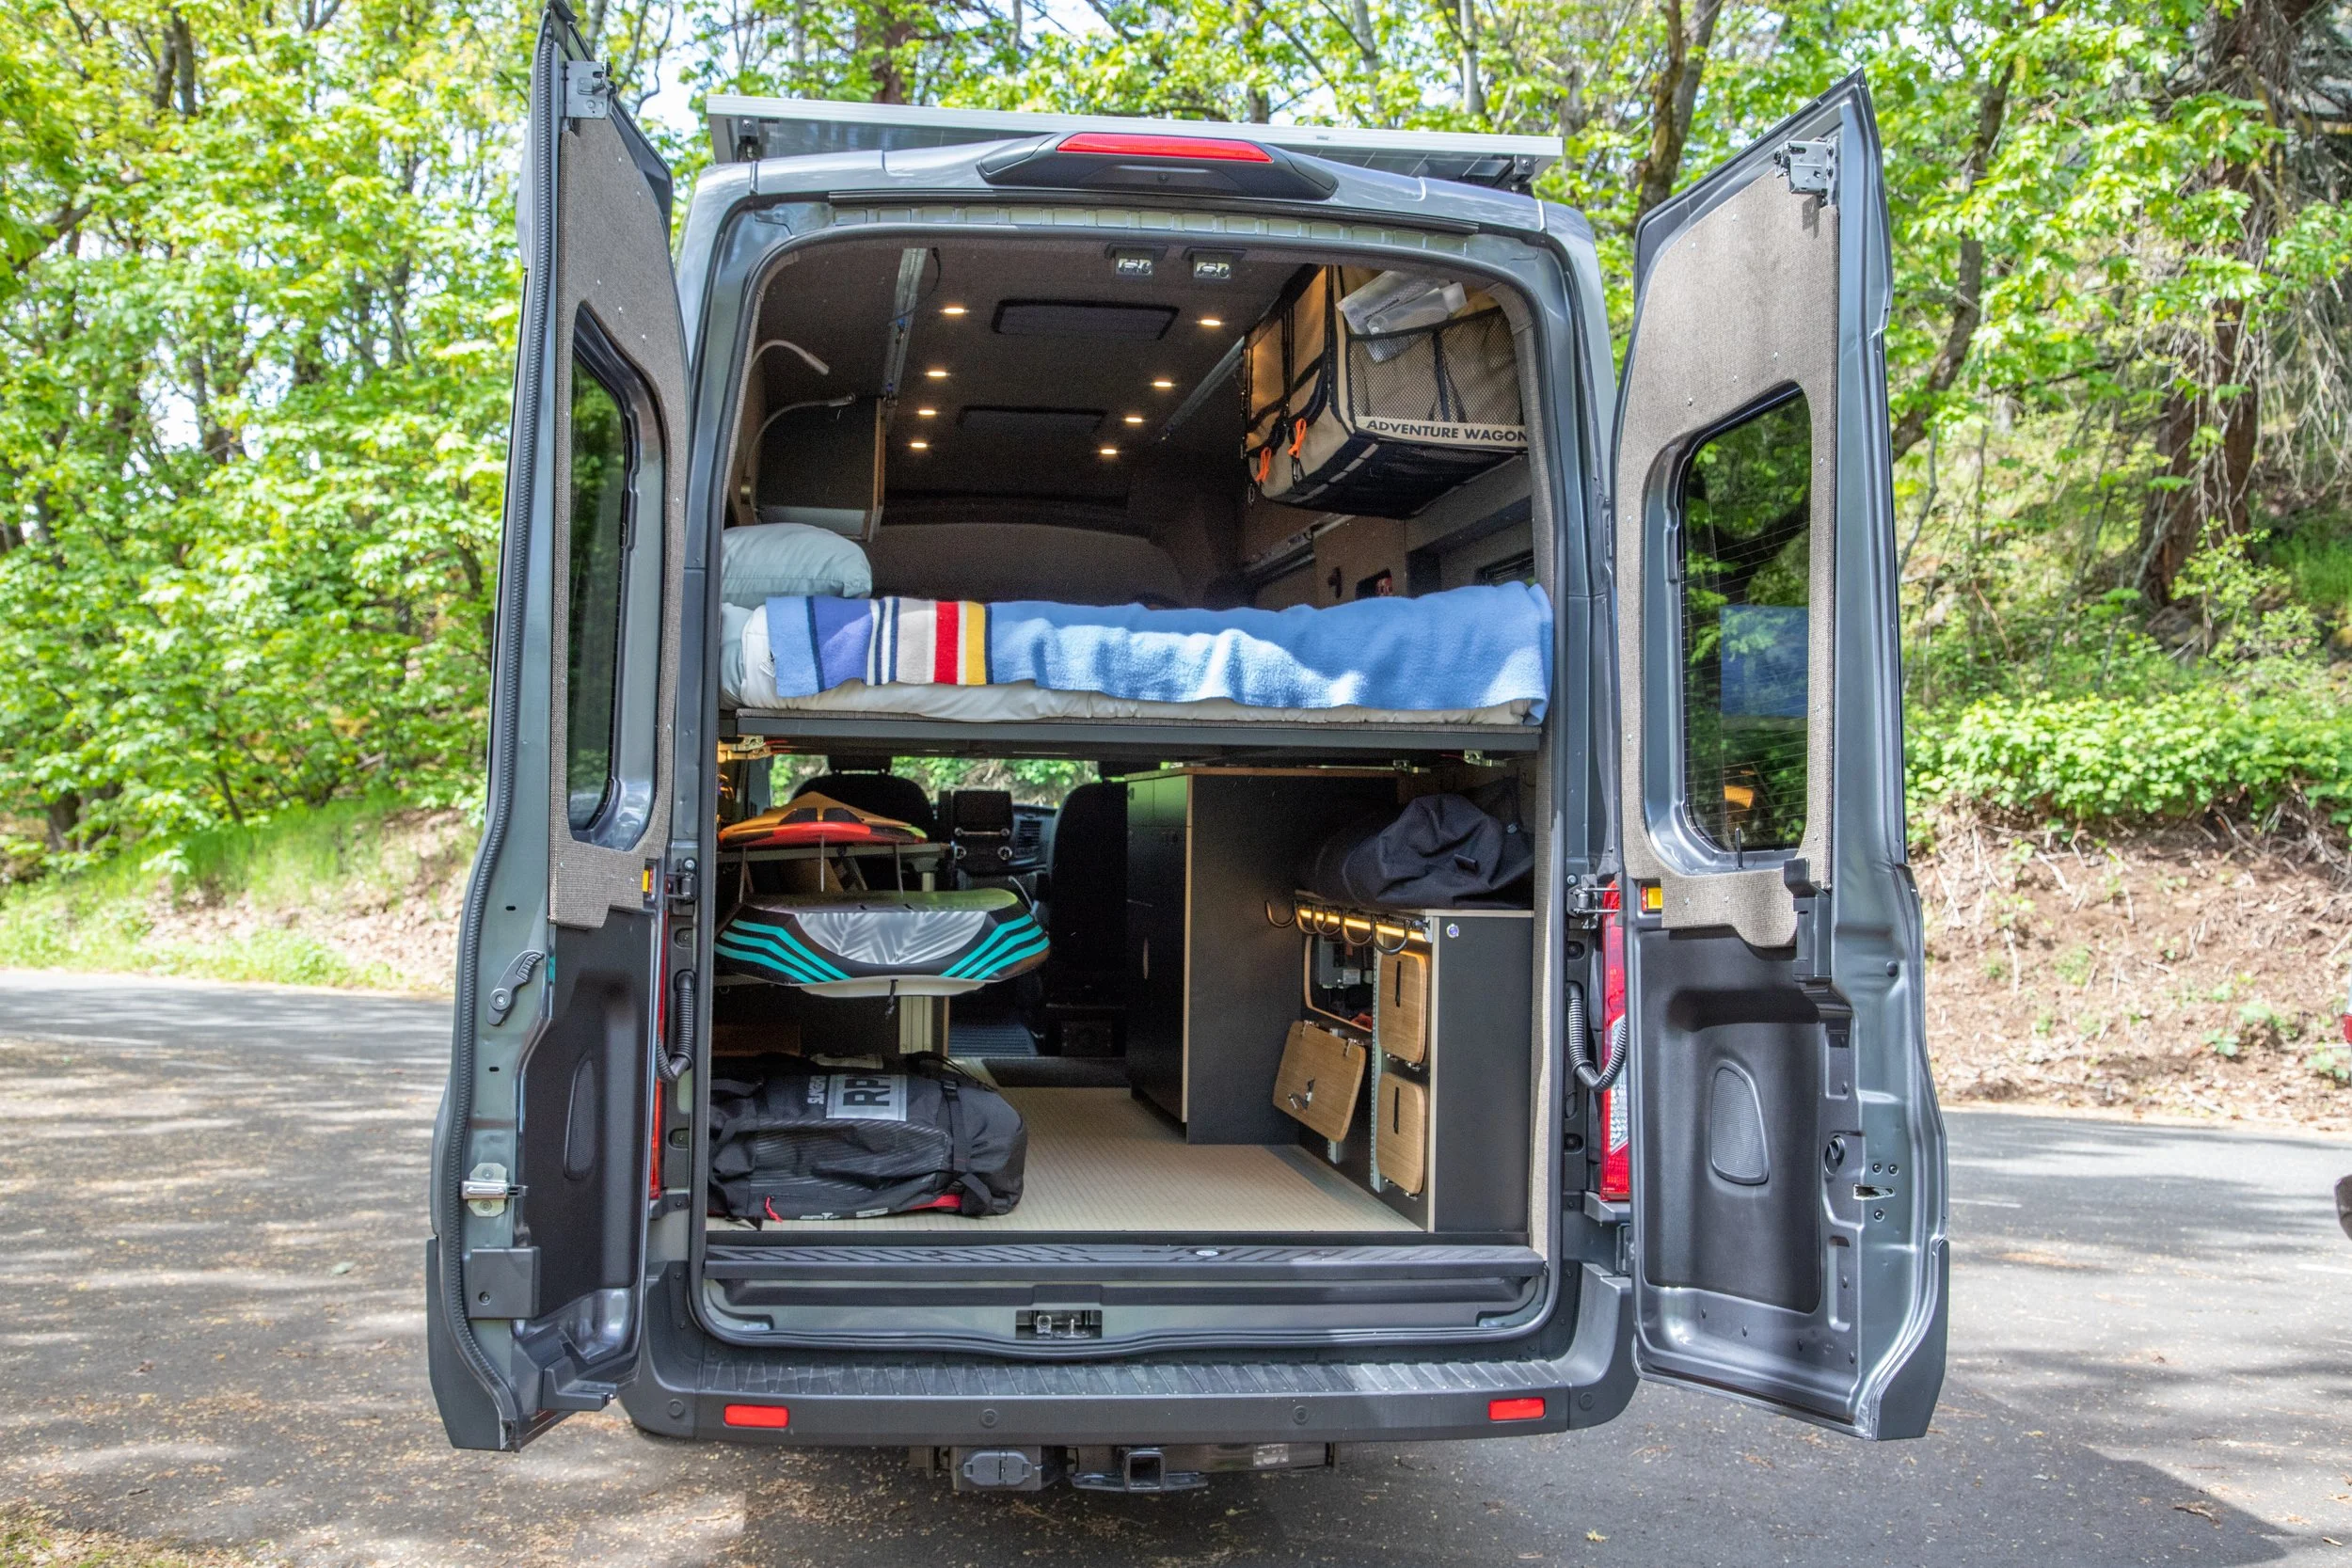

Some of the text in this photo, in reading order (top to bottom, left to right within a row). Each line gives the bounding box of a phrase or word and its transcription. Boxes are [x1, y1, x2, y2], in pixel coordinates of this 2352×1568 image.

[1366, 420, 1528, 442] ADVENTURE WAGON
[843, 1074, 891, 1106] RP
